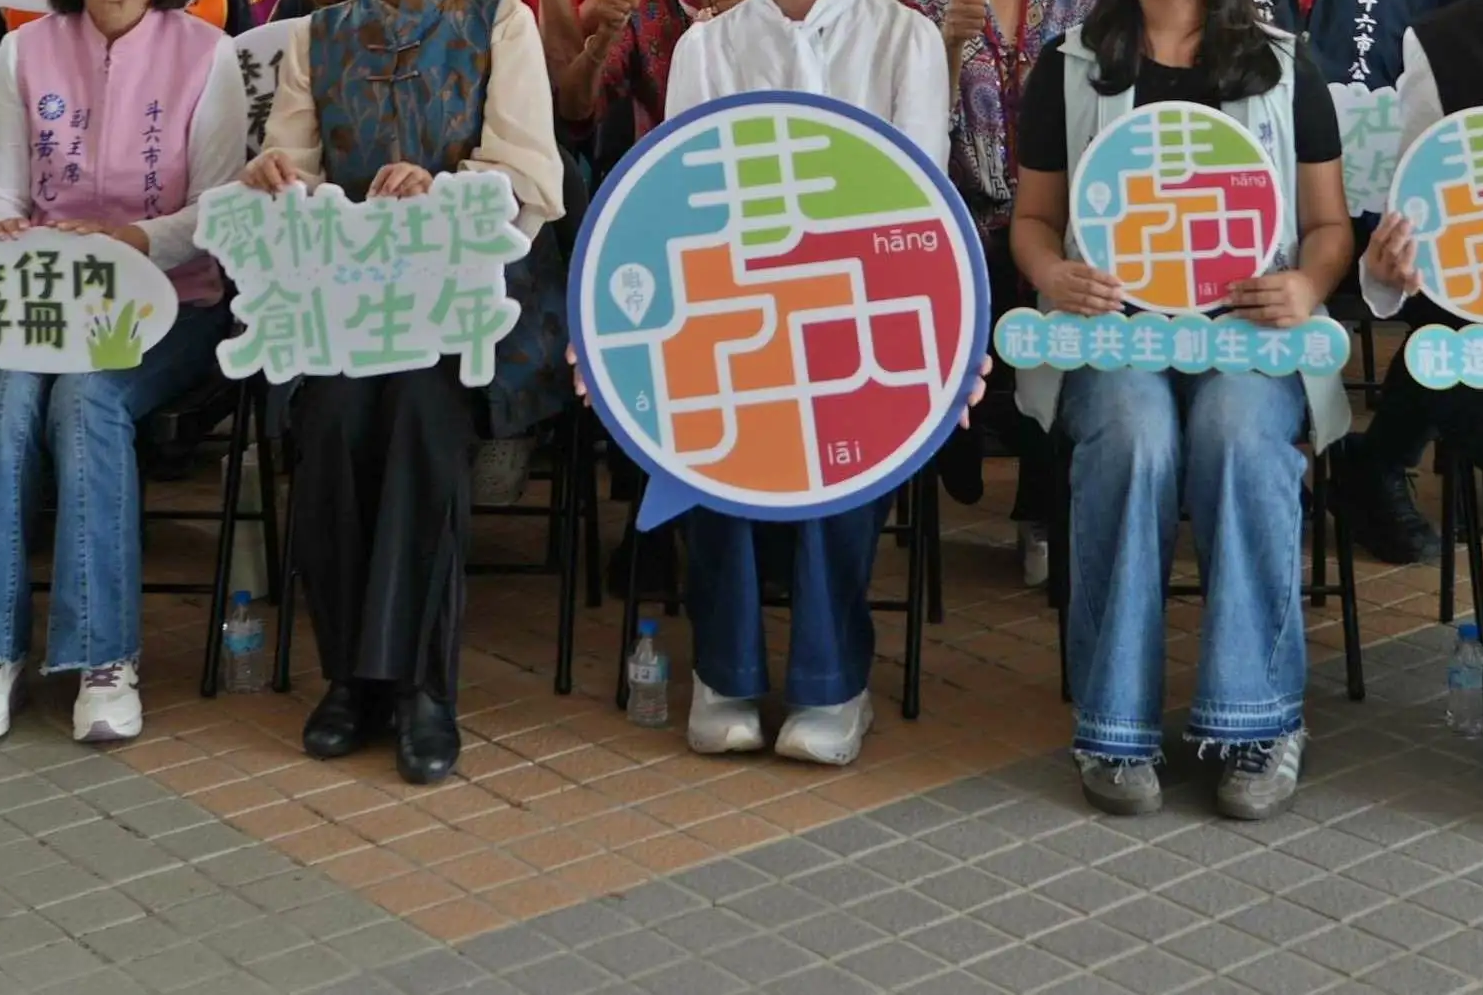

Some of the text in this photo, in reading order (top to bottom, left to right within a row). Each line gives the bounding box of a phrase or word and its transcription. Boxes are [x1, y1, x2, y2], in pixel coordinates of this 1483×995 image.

[61, 108, 92, 184] 副主席
[206, 178, 517, 272] 雲林社造
[873, 229, 939, 255] hāng
[229, 277, 508, 377] 創生年
[1005, 323, 1335, 367] 社造共生創生不息
[828, 440, 862, 466] lāi
